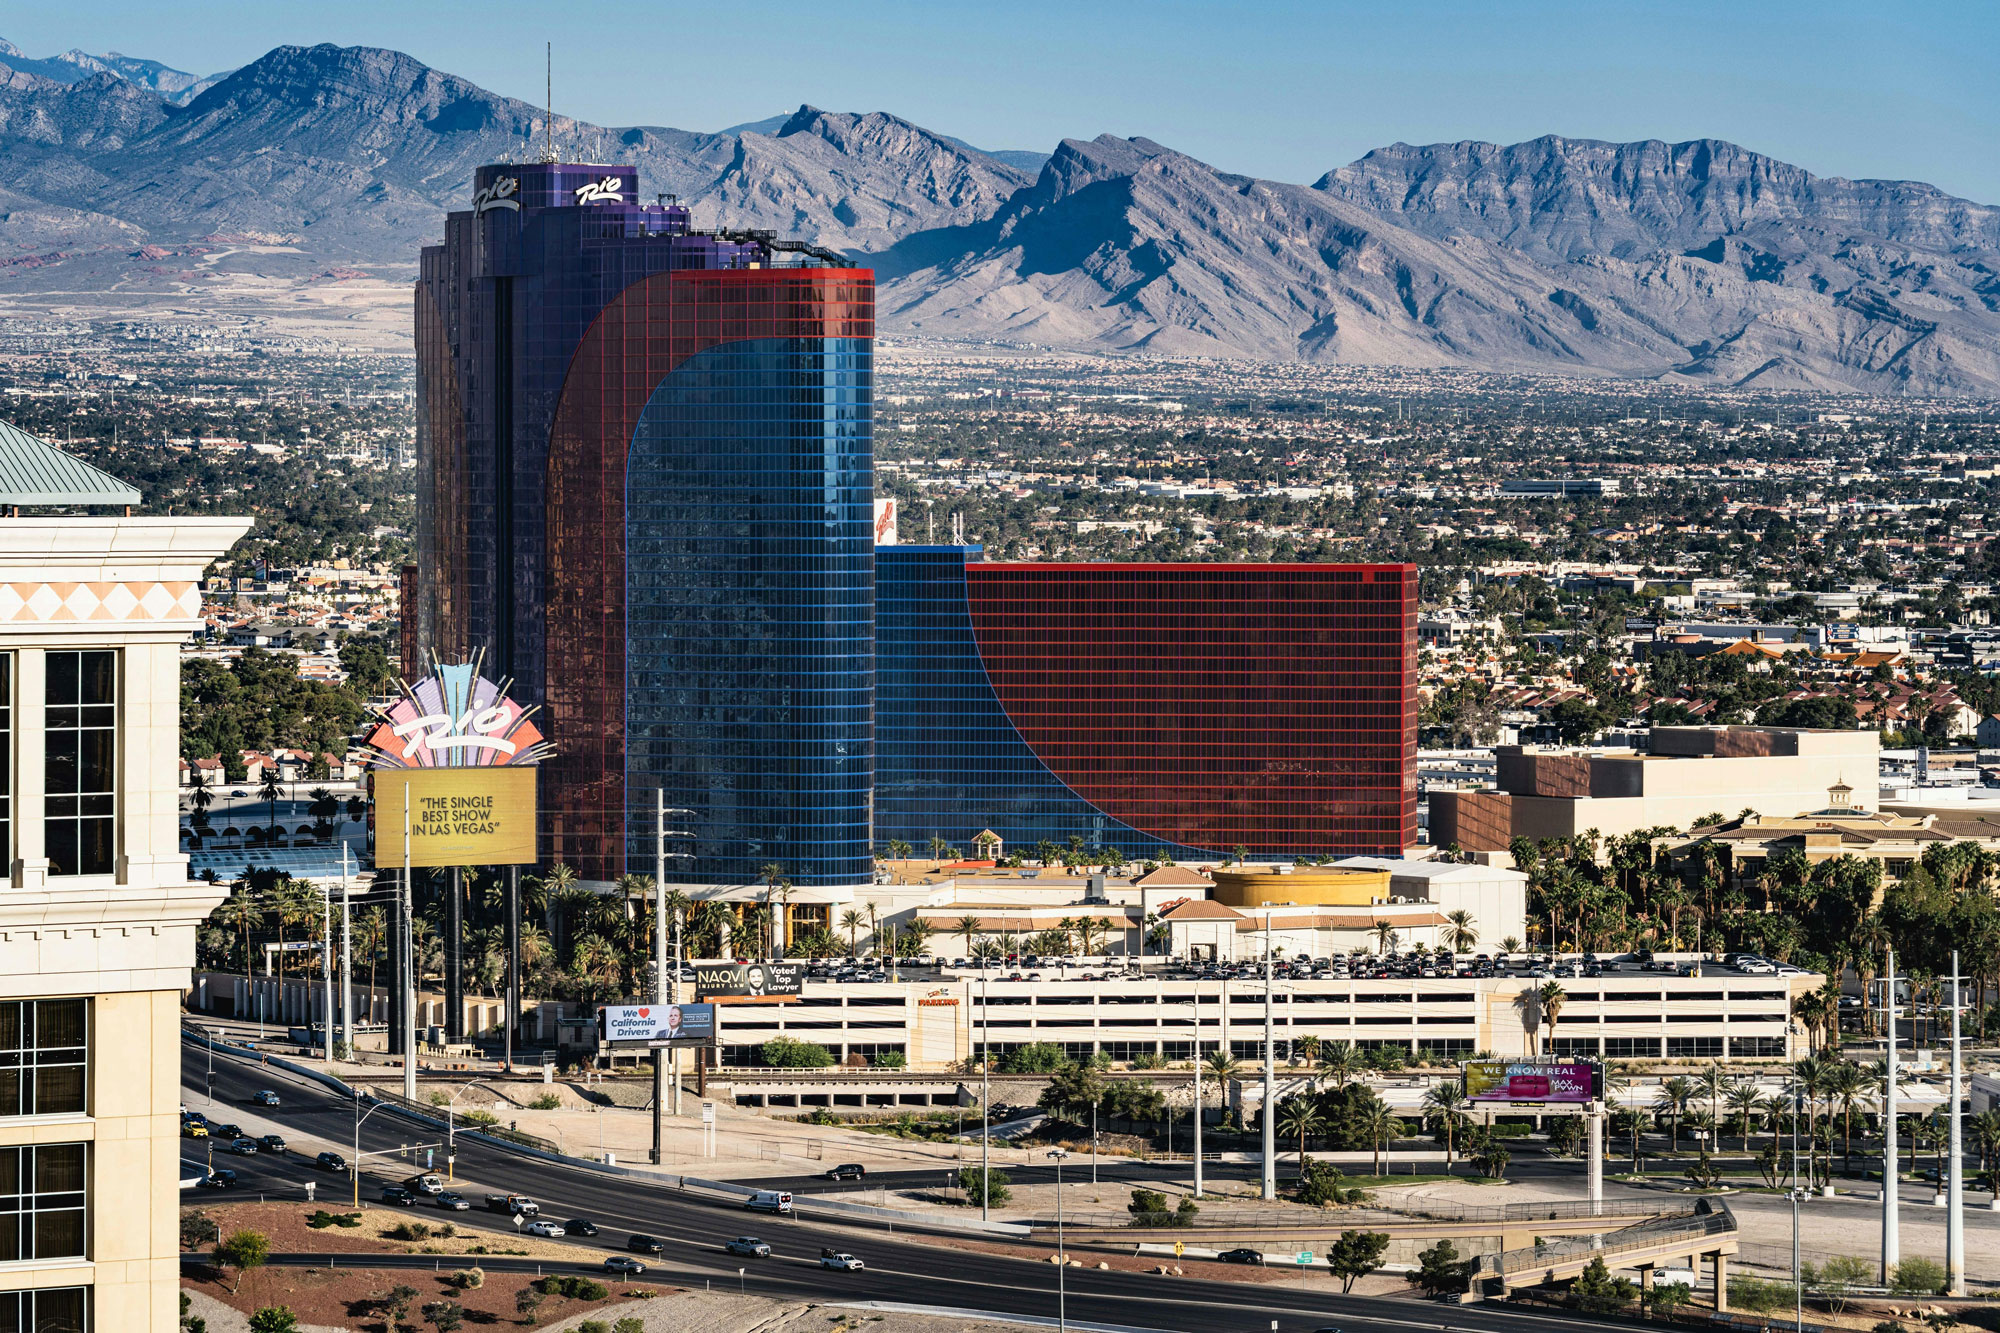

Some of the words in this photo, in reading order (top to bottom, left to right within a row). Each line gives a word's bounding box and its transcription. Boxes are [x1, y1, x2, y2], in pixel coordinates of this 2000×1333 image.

[472, 175, 520, 218] Rio
[575, 176, 624, 206] Rio
[392, 698, 517, 758] Rio
[420, 797, 447, 809] “THE
[450, 796, 493, 808] SINGLE
[422, 810, 449, 822] BEST
[451, 809, 491, 821] SHOW
[412, 824, 426, 836] IN
[429, 823, 451, 835] LAS
[454, 822, 500, 834] VEGAS”
[769, 966, 797, 975] Voted
[698, 970, 744, 983] NAQVI
[774, 974, 791, 984] Top
[768, 983, 799, 992] Lawyer
[622, 1009, 638, 1018] We
[611, 1018, 656, 1027] California
[617, 1028, 650, 1036] Drivers
[1505, 1067, 1542, 1075] KNOW
[1546, 1067, 1576, 1075] REAL
